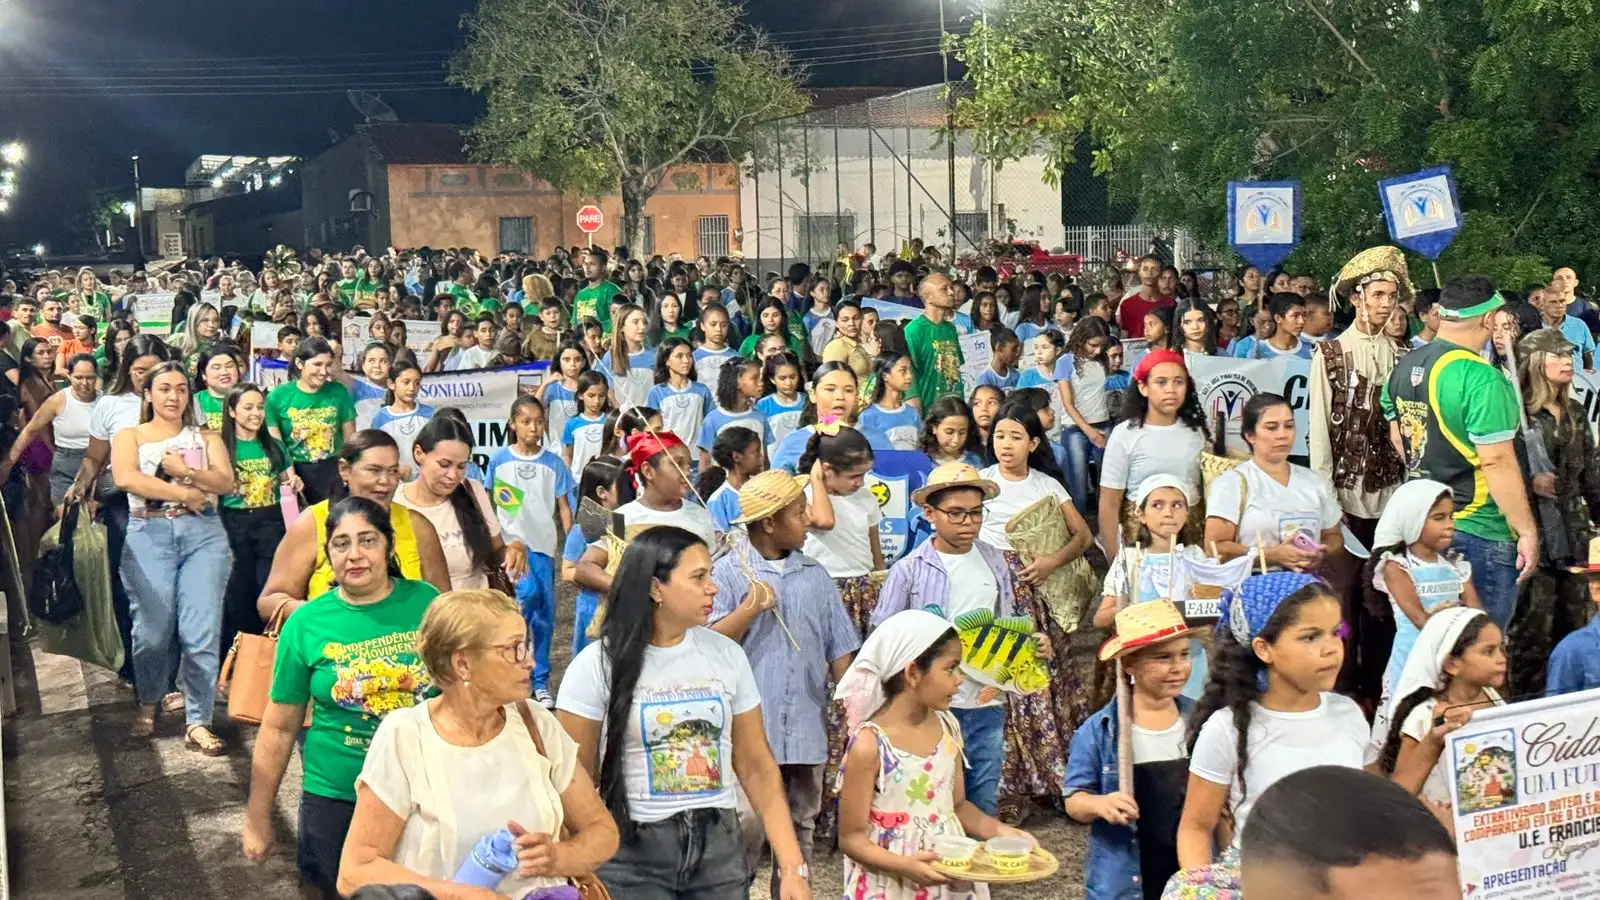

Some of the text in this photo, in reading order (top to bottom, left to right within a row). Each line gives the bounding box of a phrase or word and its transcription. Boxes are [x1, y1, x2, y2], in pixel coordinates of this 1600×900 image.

[580, 214, 601, 224] PARE
[420, 381, 485, 398] SONHADA
[1522, 771, 1557, 796] UM
[1473, 802, 1546, 828] EXTRATIVISMO
[1548, 794, 1582, 812] ONTEM
[1585, 792, 1591, 804] E
[1533, 812, 1564, 828] ENTRE
[1566, 809, 1573, 821] O
[1519, 829, 1545, 849] U.E.
[1483, 858, 1567, 890] APRESENTAÇÃO
